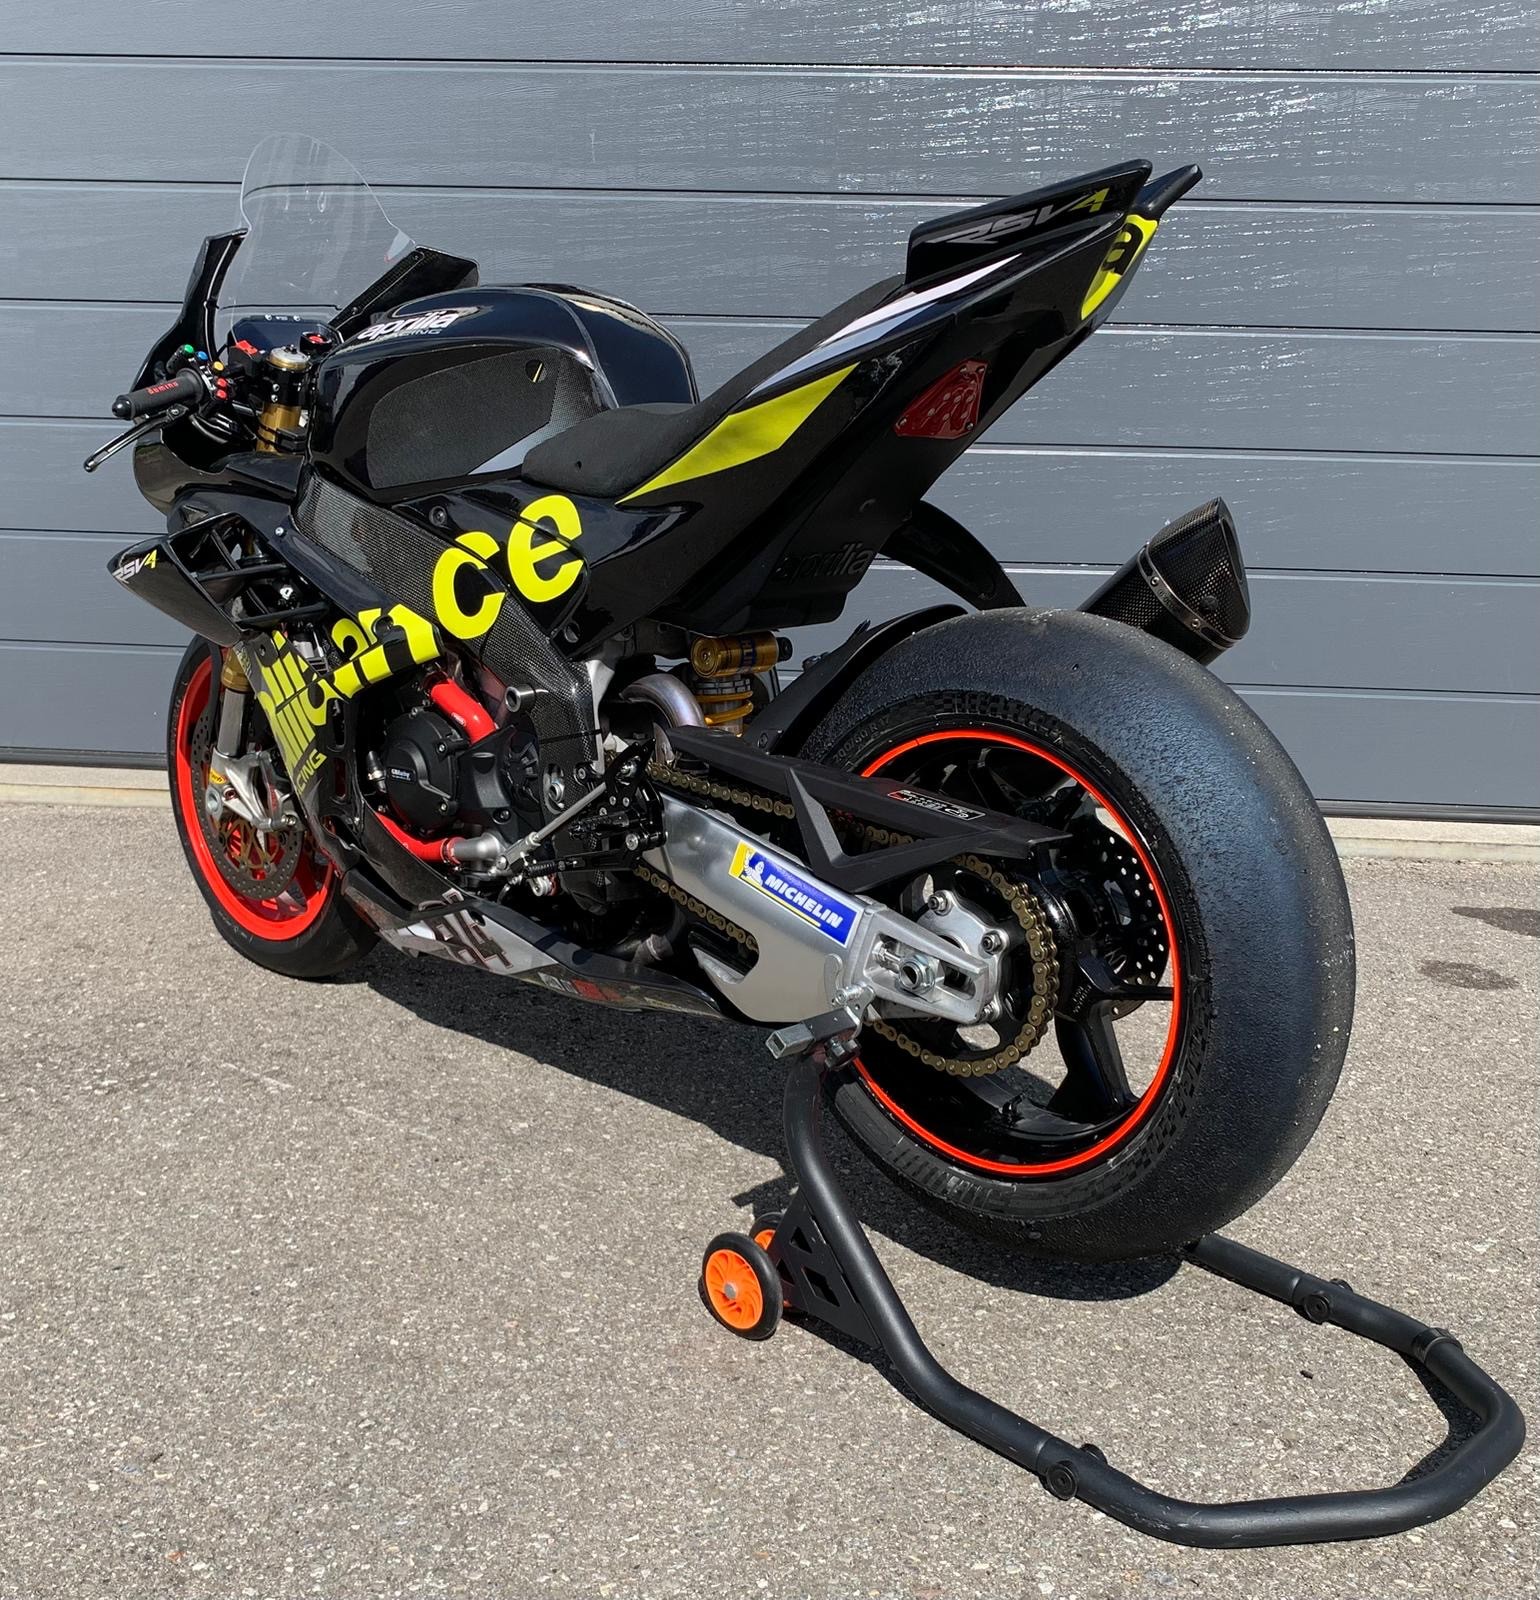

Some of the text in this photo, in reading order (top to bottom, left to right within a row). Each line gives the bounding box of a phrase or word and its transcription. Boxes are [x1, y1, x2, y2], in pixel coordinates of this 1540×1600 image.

[926, 187, 1109, 244] RSV4
[357, 310, 460, 340] aprilia
[111, 549, 158, 584] RSV4
[297, 748, 328, 795] CING
[764, 873, 844, 929] MICHELIN
